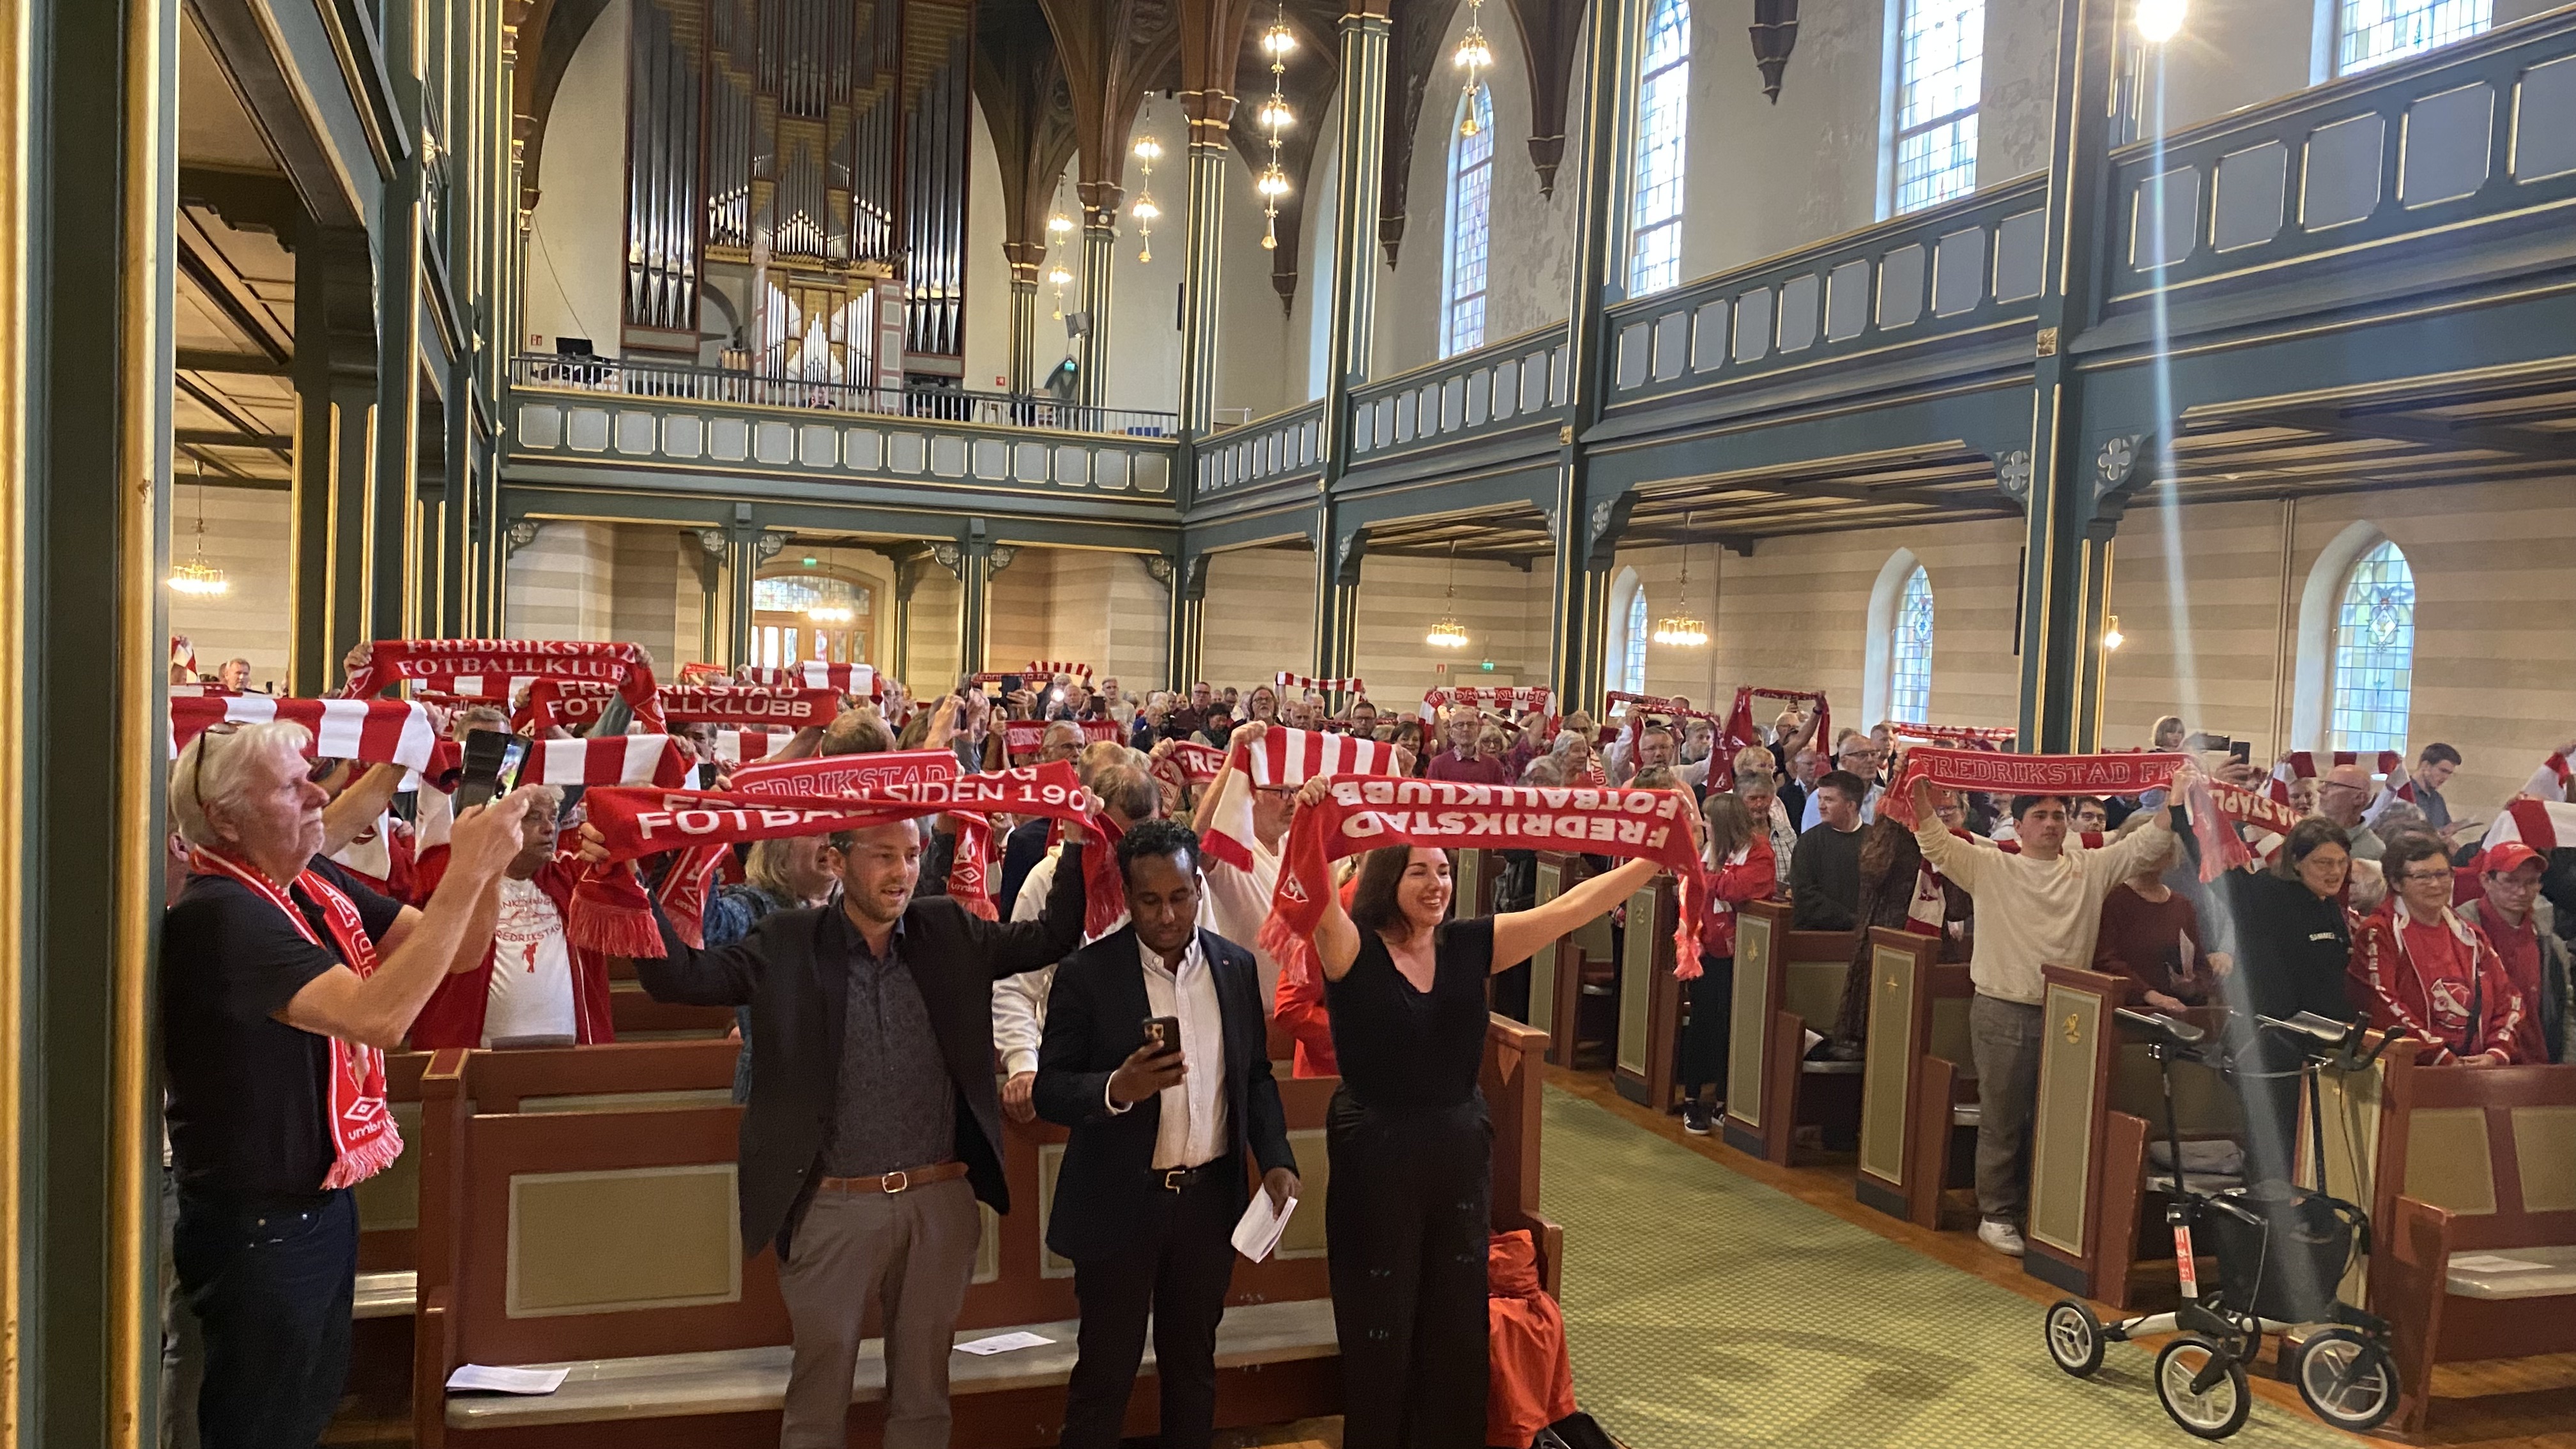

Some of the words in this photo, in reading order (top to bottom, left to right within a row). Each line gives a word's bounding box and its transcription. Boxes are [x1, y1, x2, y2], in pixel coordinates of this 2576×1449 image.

[396, 658, 625, 682] FOTBALLKLUB
[557, 680, 799, 698] FRERIKSTAD
[546, 698, 812, 718] FOTLLKLUBB
[743, 764, 956, 796] EDRIKSTAD
[1919, 753, 2131, 785] FREDRIKSTAD
[884, 781, 1005, 803] SIDEN
[1017, 784, 1086, 811] 190
[1331, 781, 1678, 820] FOTBALLKLUBB
[1342, 809, 1671, 848] FREDRIKSTAD
[496, 923, 562, 942] REDRIKSTAD
[348, 1119, 387, 1140] umbr
